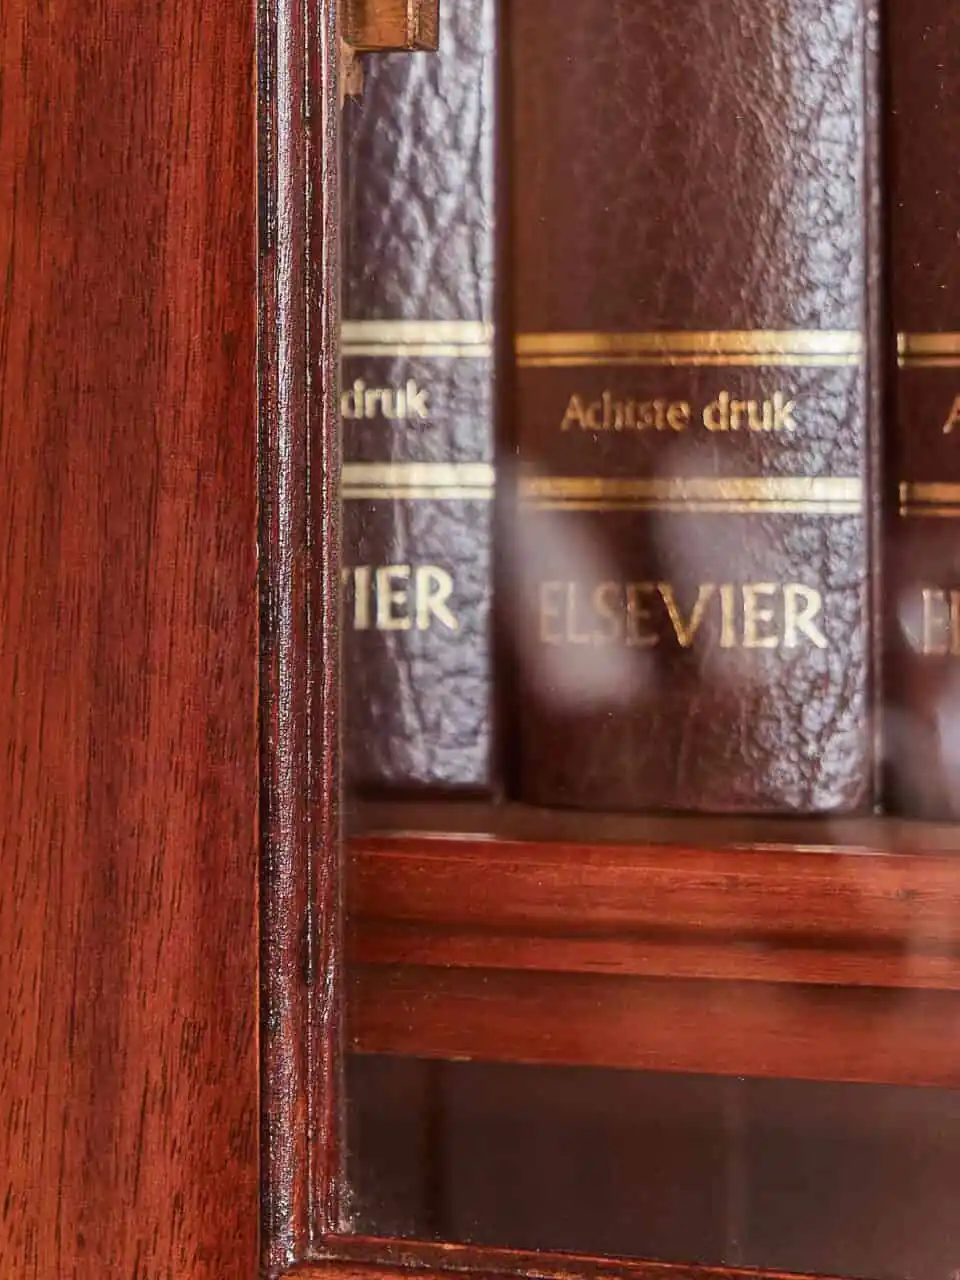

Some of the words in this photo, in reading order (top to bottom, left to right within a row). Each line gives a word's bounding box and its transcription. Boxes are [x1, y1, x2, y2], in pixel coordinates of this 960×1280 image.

[340, 378, 429, 420] druk
[702, 391, 798, 433] druk
[341, 565, 459, 631] IER
[541, 581, 829, 649] ELSEVIER
